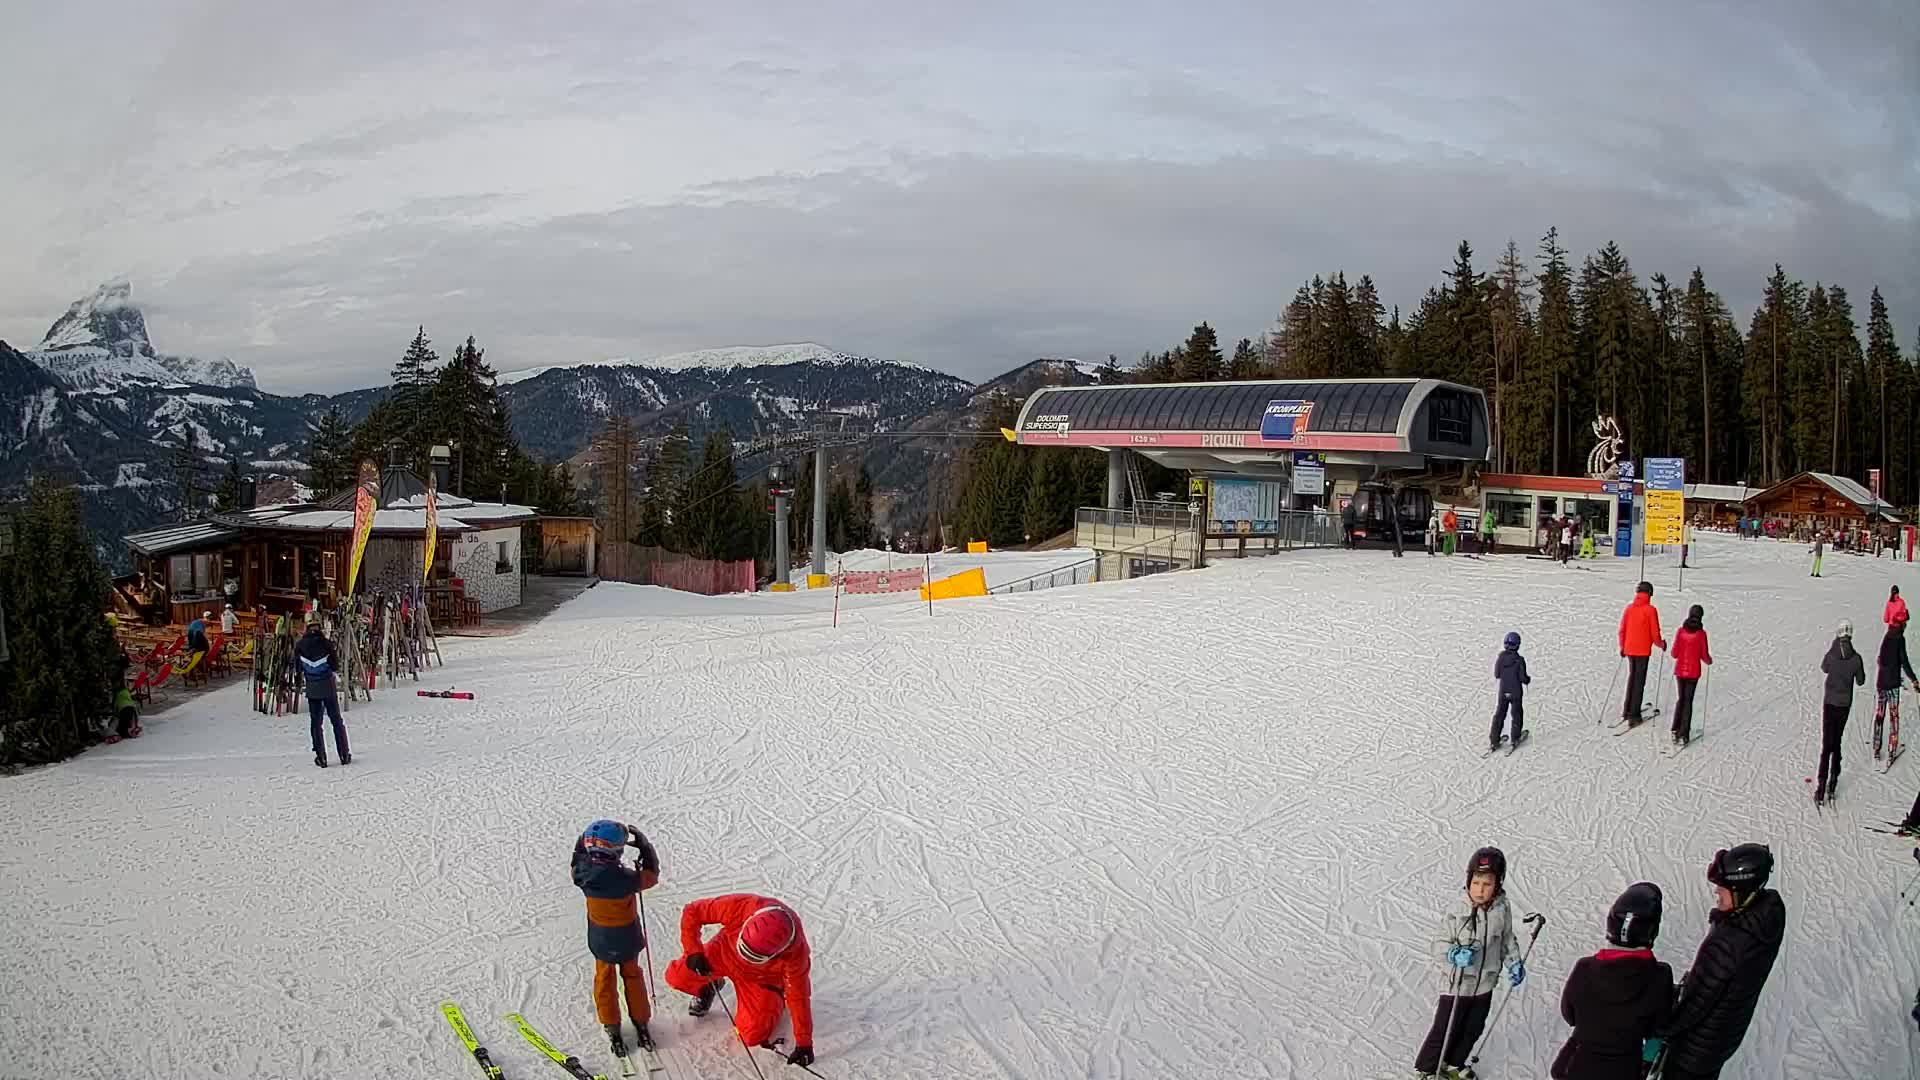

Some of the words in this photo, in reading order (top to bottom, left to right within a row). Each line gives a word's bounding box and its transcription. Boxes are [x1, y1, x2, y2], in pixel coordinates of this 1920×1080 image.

[1266, 404, 1310, 414] KRONPLATZ
[1025, 422, 1059, 430] SUPERSKI
[1201, 434, 1245, 447] PICULIN
